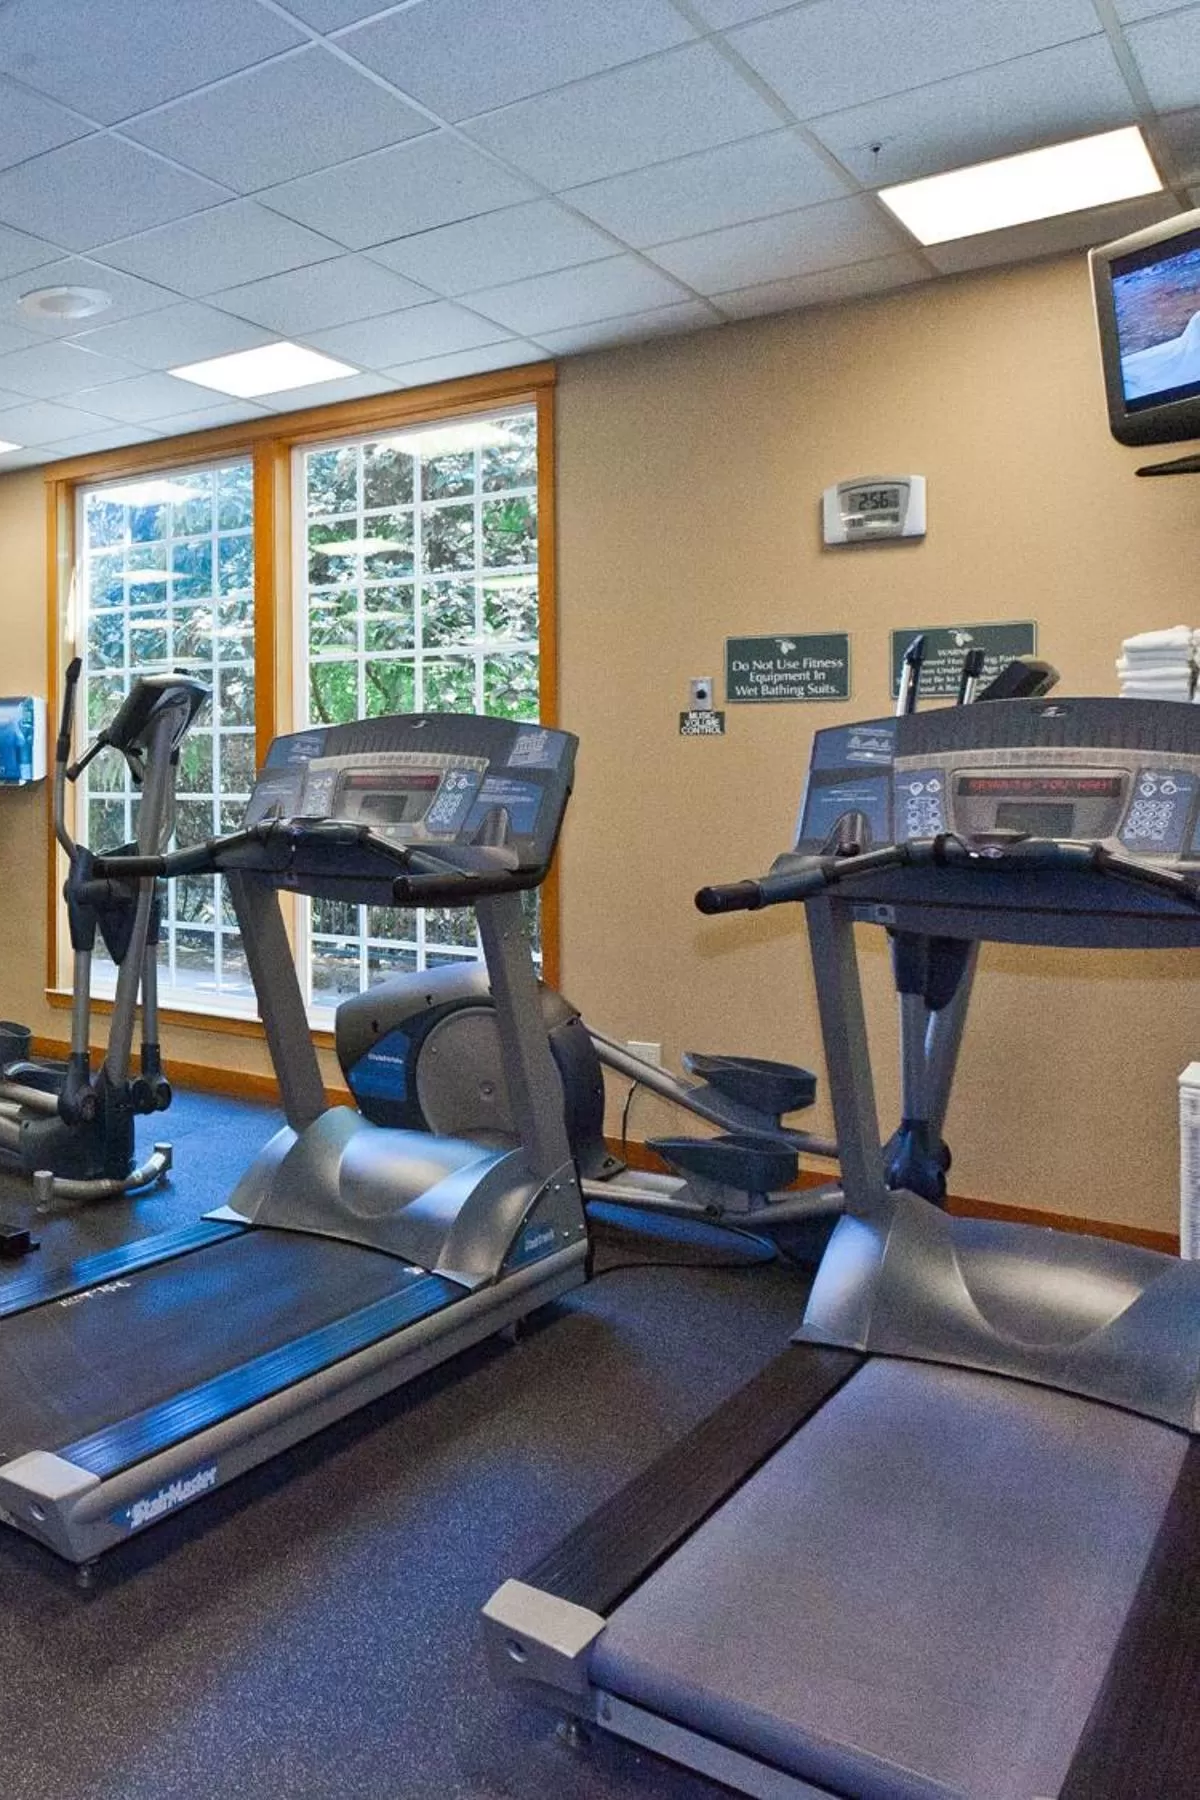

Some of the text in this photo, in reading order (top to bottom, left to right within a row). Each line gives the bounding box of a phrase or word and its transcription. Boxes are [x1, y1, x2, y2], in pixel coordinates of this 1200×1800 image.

[732, 656, 844, 672] Do Not Use Fitness
[749, 669, 826, 684] Equipment In
[735, 682, 840, 699] Wet Bathing Suits.
[684, 719, 721, 727] VOLUME
[681, 727, 722, 736] CONTROL
